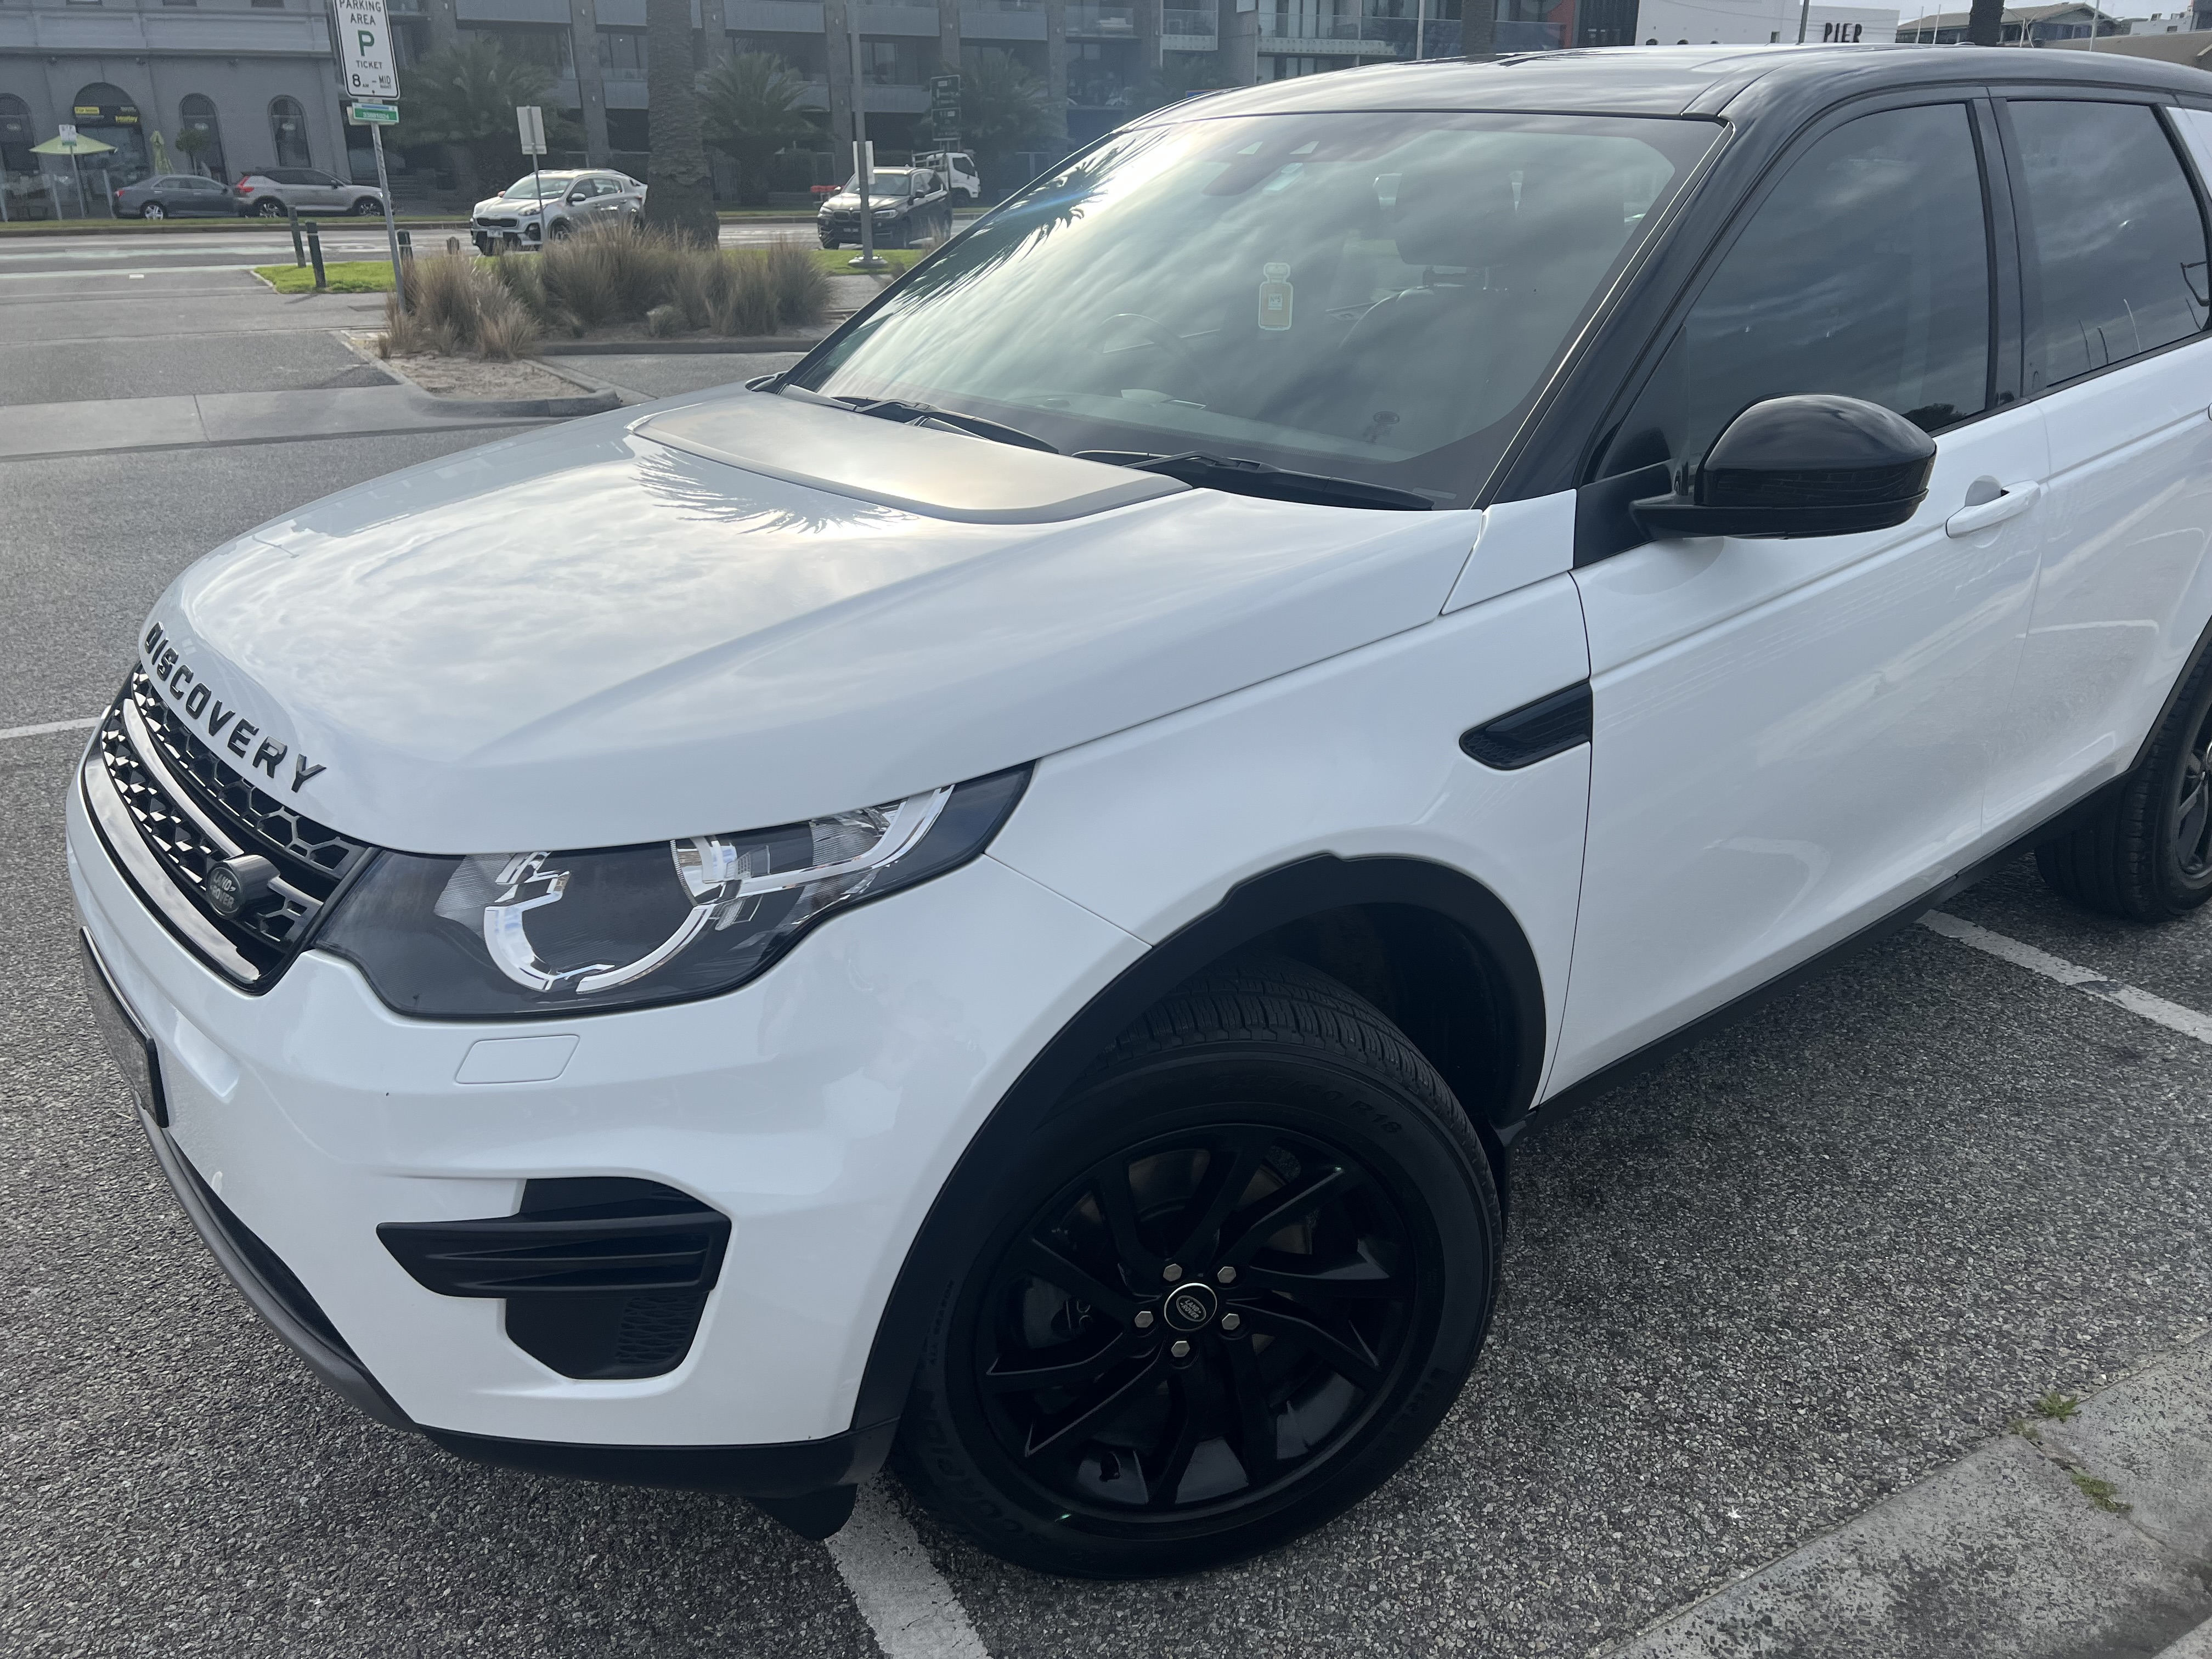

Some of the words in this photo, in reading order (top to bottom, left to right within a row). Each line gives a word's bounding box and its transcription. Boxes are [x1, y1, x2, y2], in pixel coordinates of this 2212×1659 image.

[340, 0, 381, 13] PARKING
[351, 13, 376, 26] AREA
[1823, 22, 1863, 42] PIER
[358, 30, 375, 57] P
[356, 60, 382, 70] TICKET
[352, 73, 361, 87] 8
[378, 75, 391, 84] MID
[144, 621, 327, 793] DISCOVERY
[1181, 1305, 1199, 1319] ROVER
[1184, 1299, 1200, 1312] LAND
